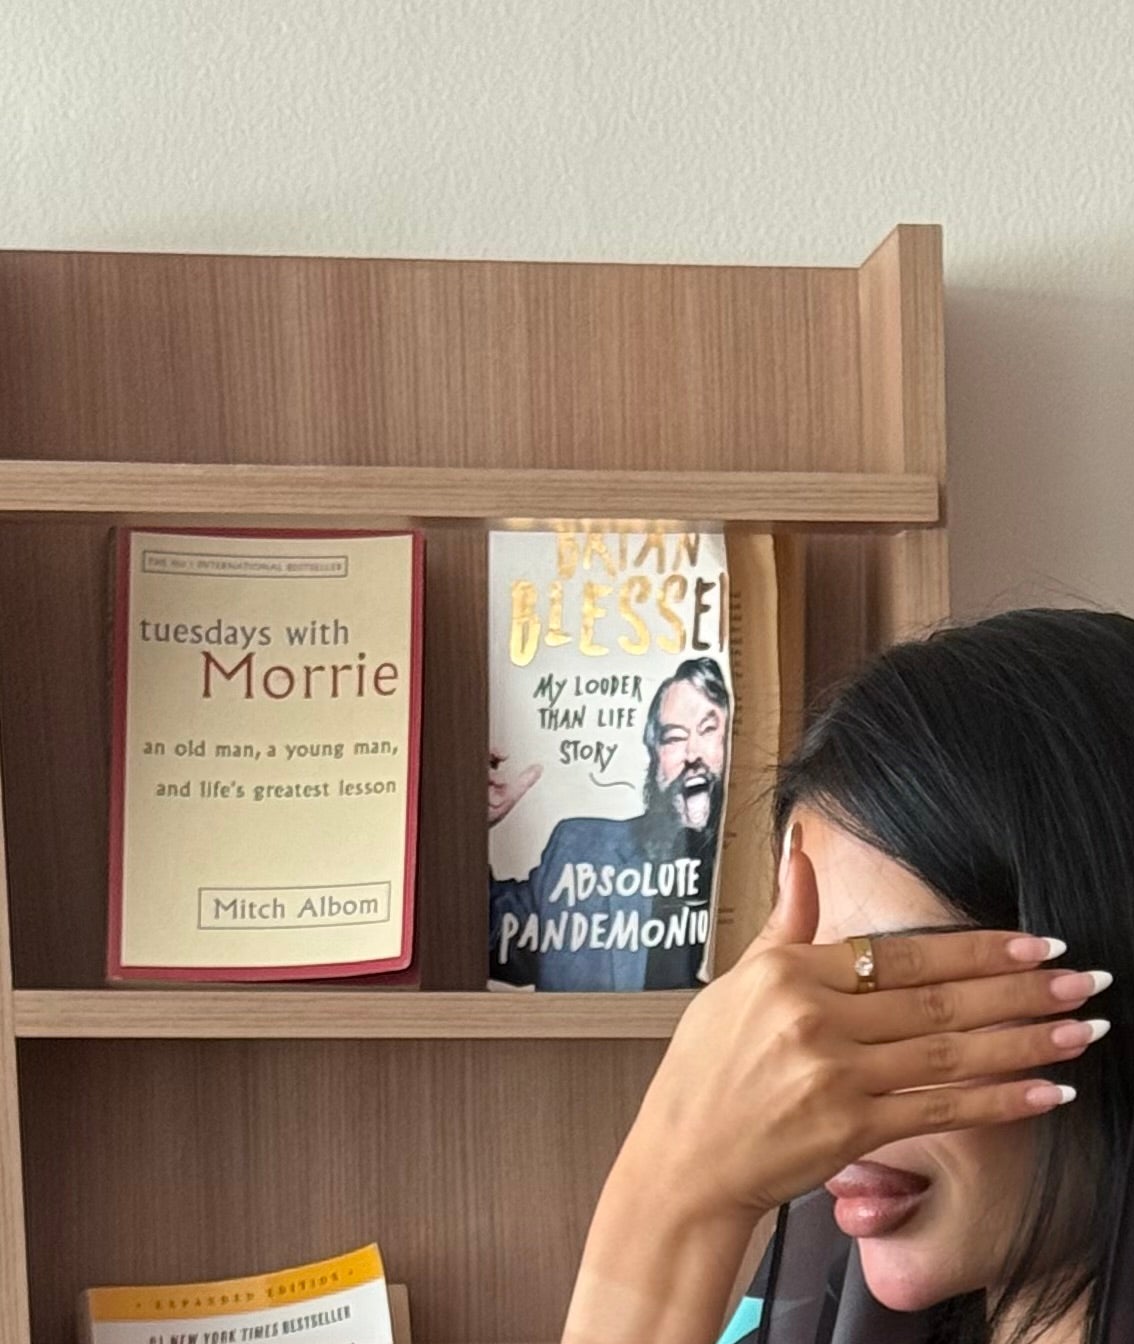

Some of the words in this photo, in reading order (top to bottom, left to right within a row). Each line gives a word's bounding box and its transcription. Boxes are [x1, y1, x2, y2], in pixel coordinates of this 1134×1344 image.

[139, 618, 272, 650] tuesdays
[286, 618, 350, 646] with
[509, 571, 730, 667] BLESSE
[202, 650, 399, 699] Morrie
[537, 704, 587, 731] THAN
[599, 706, 637, 730] LIFE
[143, 741, 165, 755] an
[174, 740, 206, 757] old
[215, 744, 261, 760] man,
[267, 744, 277, 757] a
[285, 742, 344, 760] young
[353, 740, 399, 756] man,
[560, 739, 618, 773] STORY
[156, 781, 191, 797] and
[200, 780, 245, 798] life's
[253, 782, 329, 801] greatest
[339, 779, 397, 796] lesson
[549, 857, 702, 907] ABSOLUTE
[213, 896, 286, 919] Mitch
[297, 895, 379, 919] Albom
[497, 905, 710, 965] PANDEMONIU
[240, 1323, 280, 1342] TIMES
[281, 1304, 352, 1335] BESTSELLER
